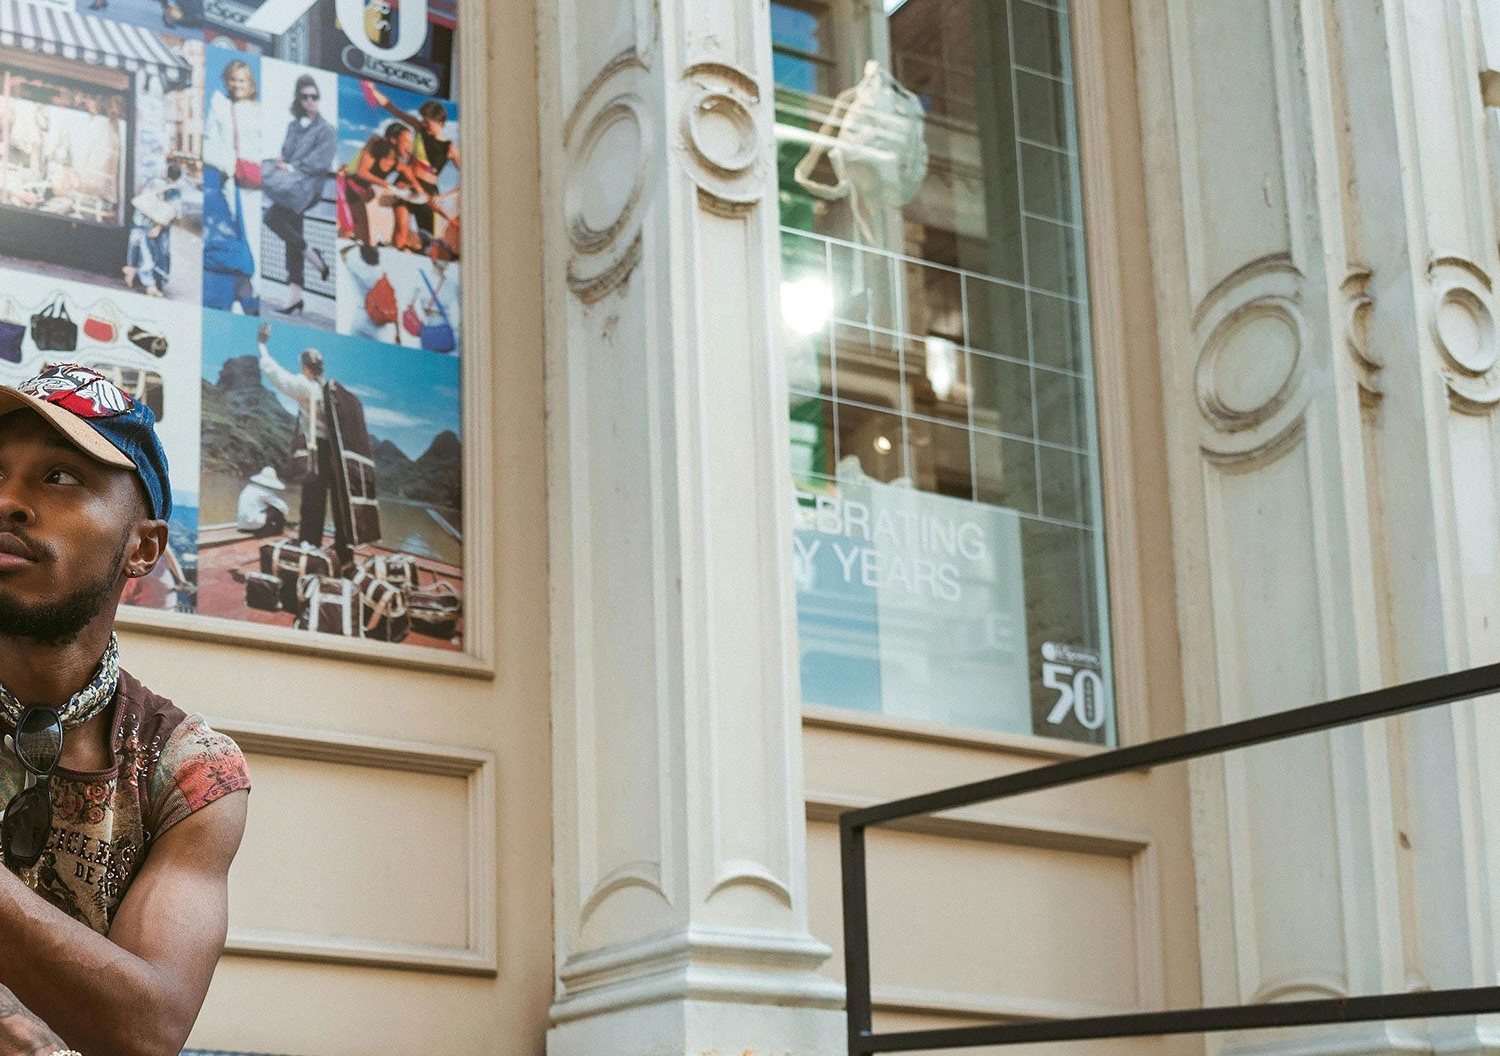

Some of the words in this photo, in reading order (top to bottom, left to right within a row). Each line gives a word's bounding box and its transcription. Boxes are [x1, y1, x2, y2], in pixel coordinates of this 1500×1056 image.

[832, 541, 962, 601] YEARS
[1042, 662, 1105, 730] 50
[75, 861, 95, 885] DE
